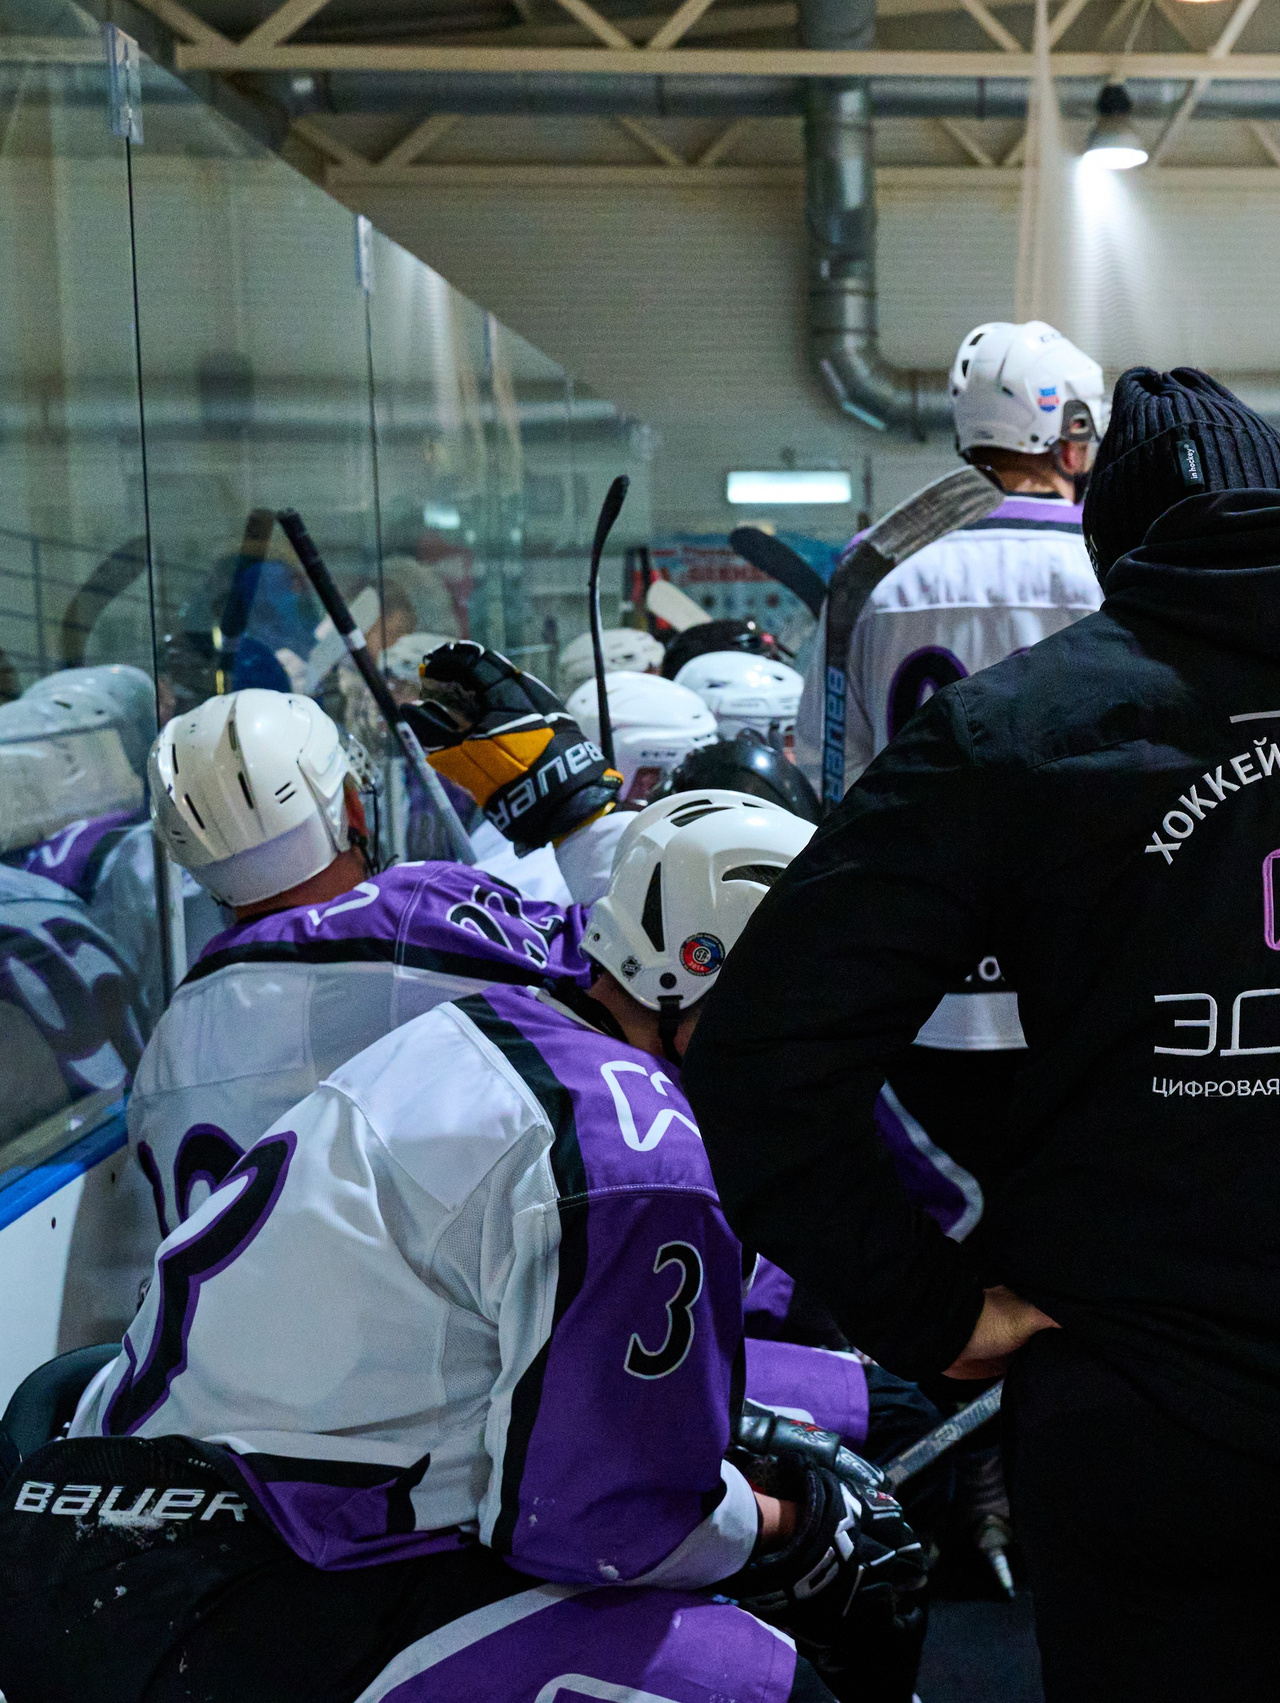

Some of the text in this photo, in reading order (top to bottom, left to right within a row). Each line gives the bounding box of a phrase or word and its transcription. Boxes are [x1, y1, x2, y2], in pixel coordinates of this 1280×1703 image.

[823, 665, 846, 804] BAUER
[486, 741, 605, 832] BAUER
[1152, 1077, 1279, 1098] ЦИФРОВАЯ
[623, 1240, 704, 1380] 3
[14, 1480, 249, 1522] BAUER
